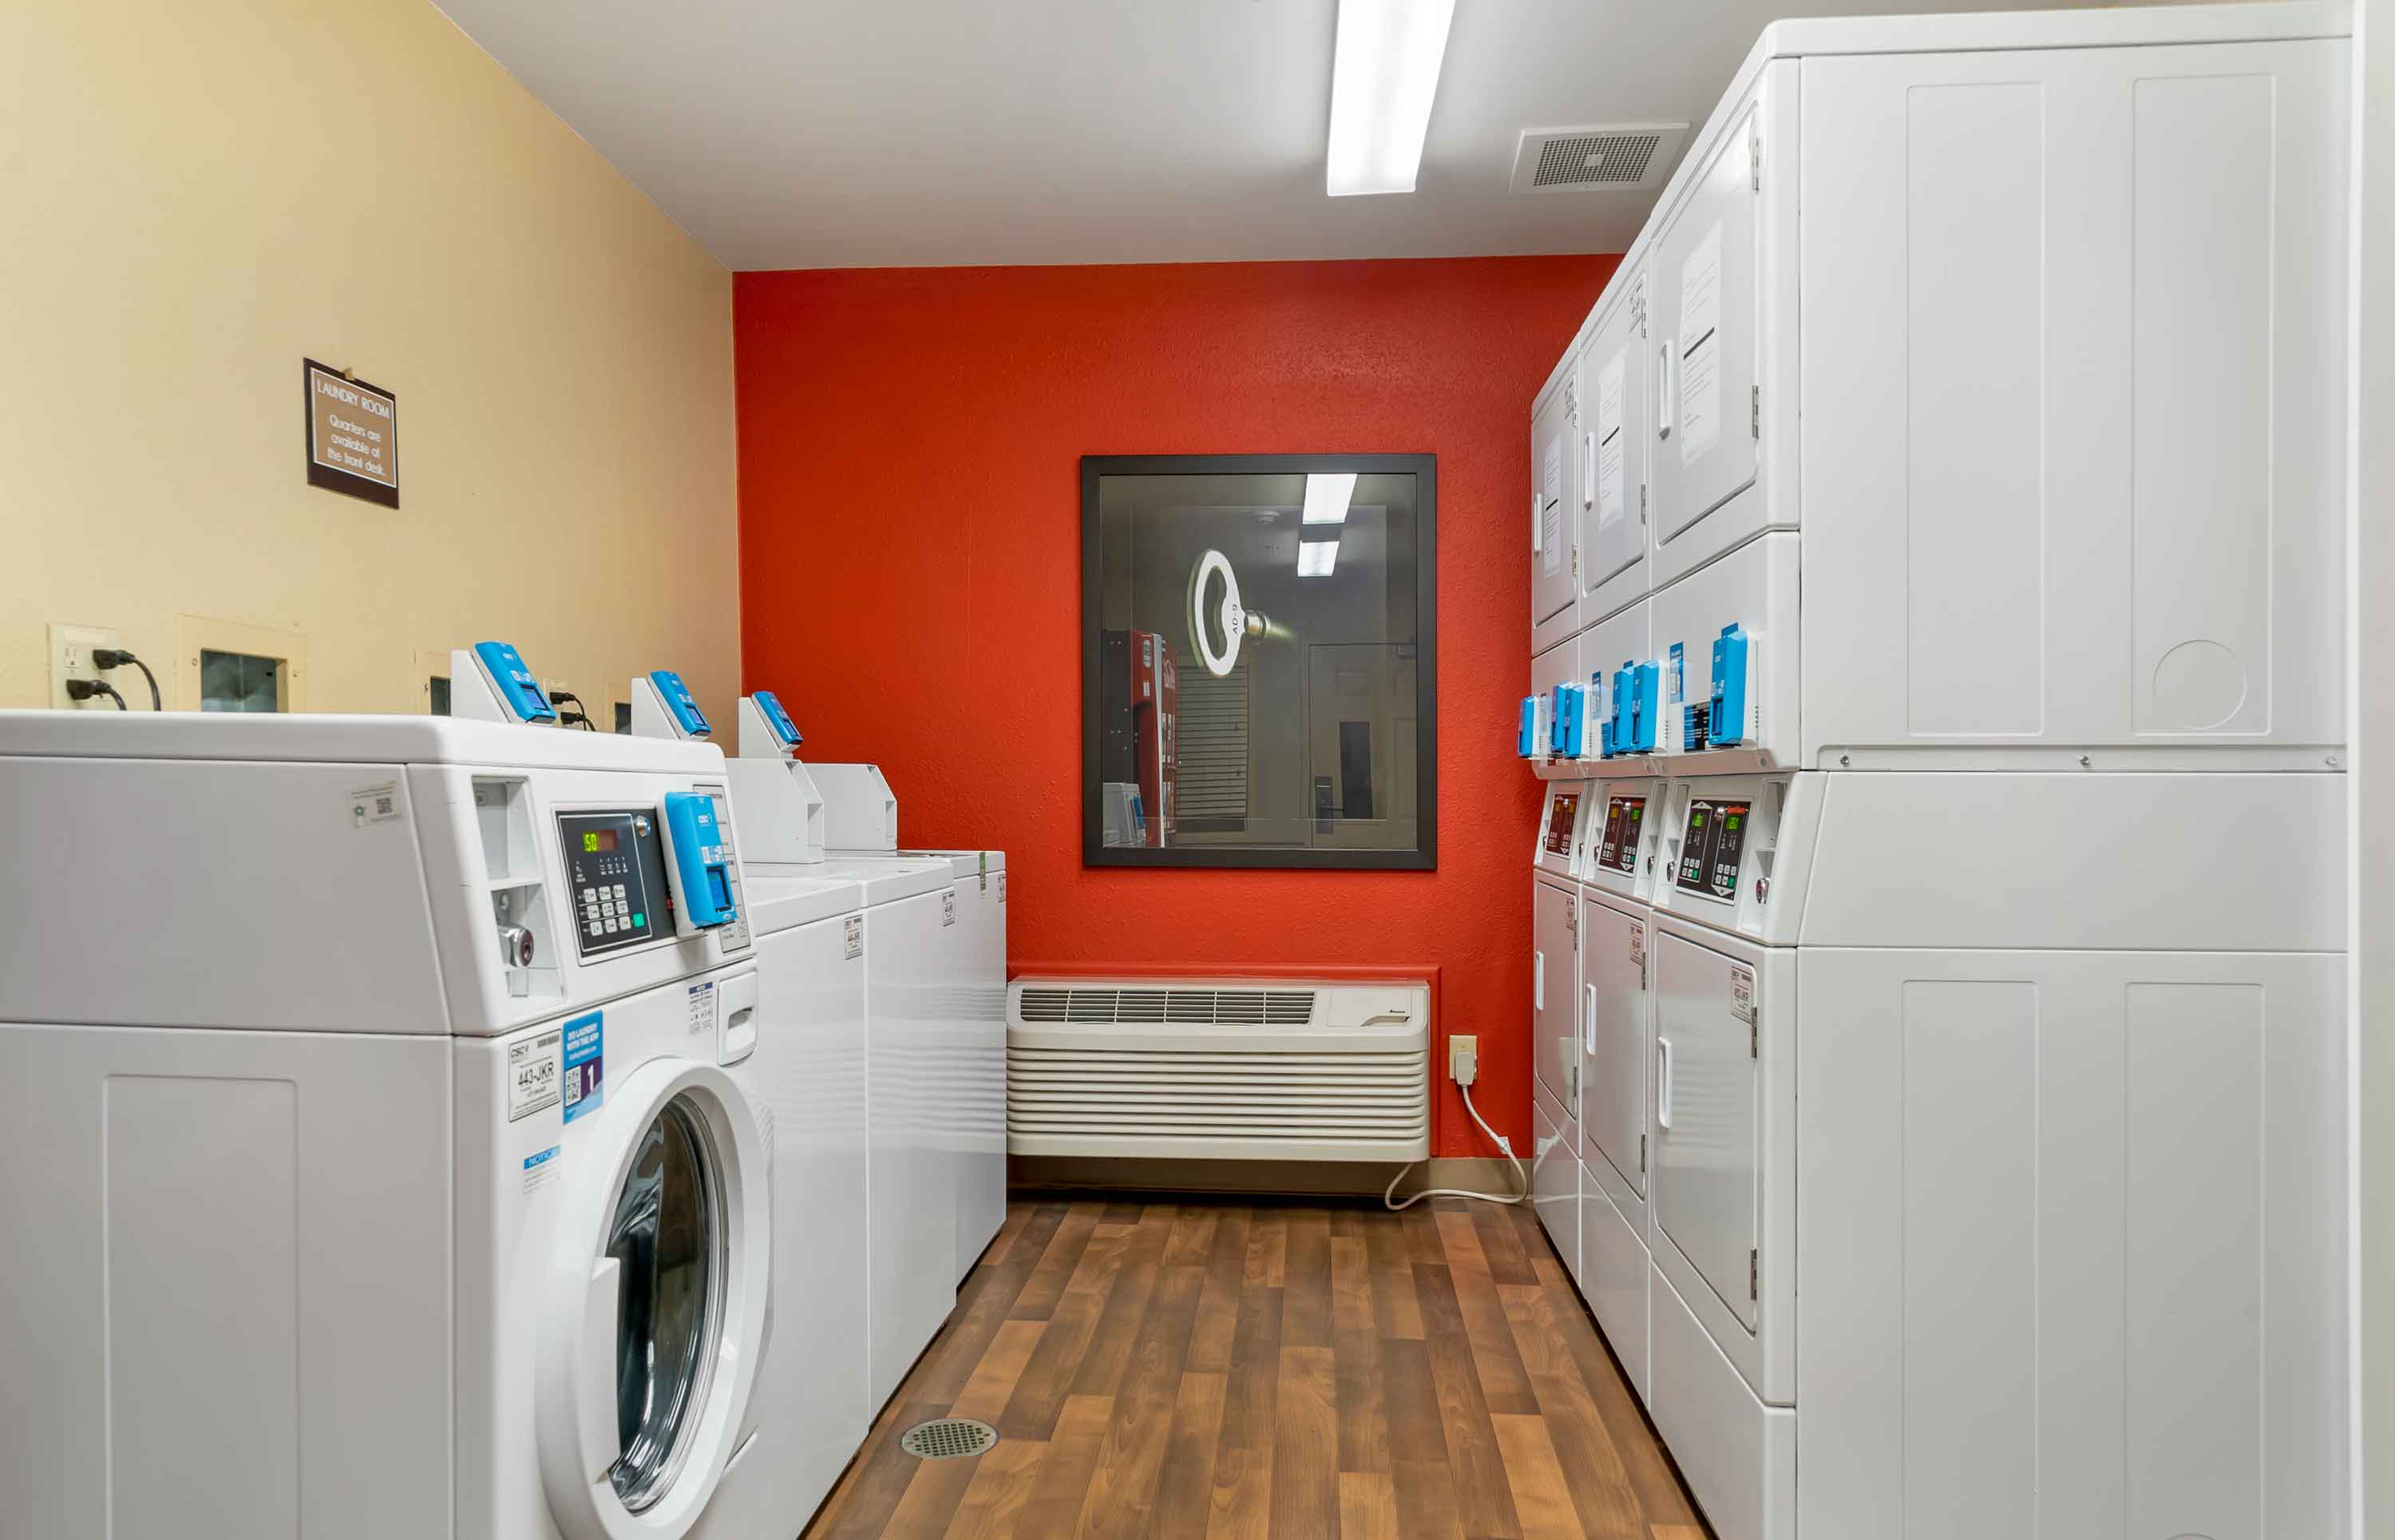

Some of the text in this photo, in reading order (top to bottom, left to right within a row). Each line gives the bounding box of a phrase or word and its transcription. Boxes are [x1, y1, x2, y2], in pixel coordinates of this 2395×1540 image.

[317, 379, 390, 418] LAUNDRY ROOM
[330, 414, 382, 442] Quarters are
[327, 446, 342, 461] the
[344, 452, 362, 469] front
[331, 433, 381, 460] available at
[587, 1064, 595, 1093] 1
